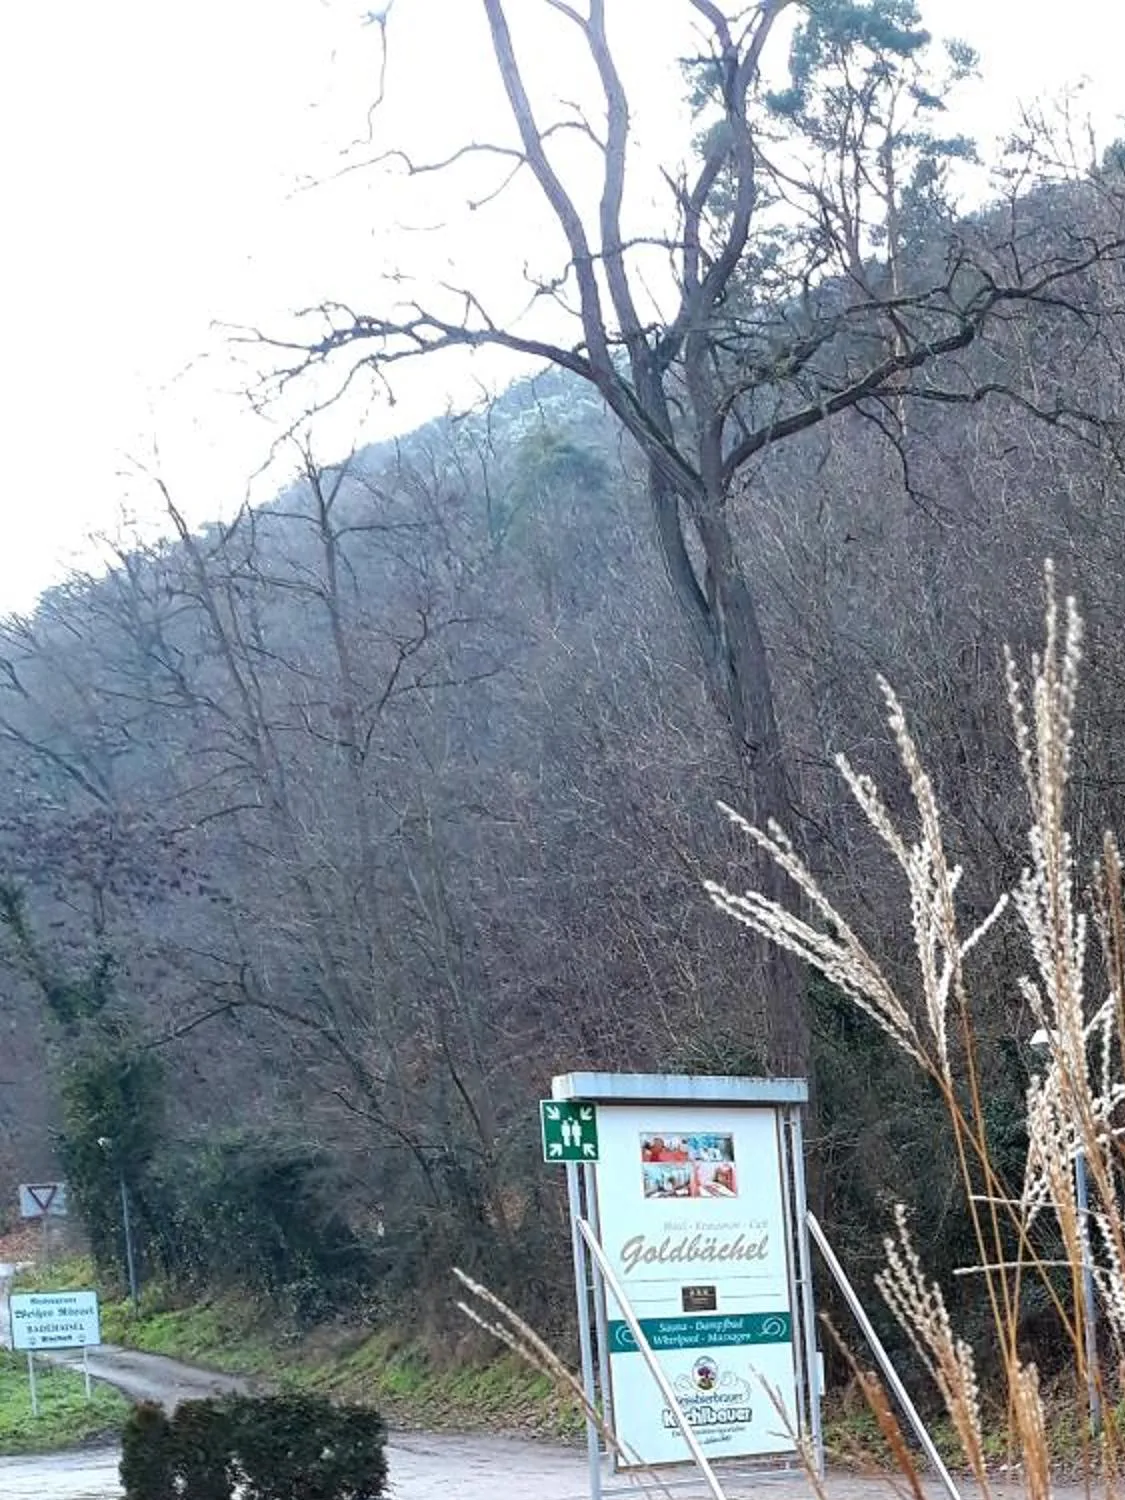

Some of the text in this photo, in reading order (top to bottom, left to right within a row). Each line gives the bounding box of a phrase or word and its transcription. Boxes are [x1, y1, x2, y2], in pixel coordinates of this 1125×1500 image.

[619, 1233, 769, 1275] Goldbächel
[658, 1322, 688, 1333] Sauna
[695, 1318, 744, 1334] Dampfbad
[652, 1333, 700, 1348] Whirlpool
[661, 1406, 753, 1429] Kchlbauer
